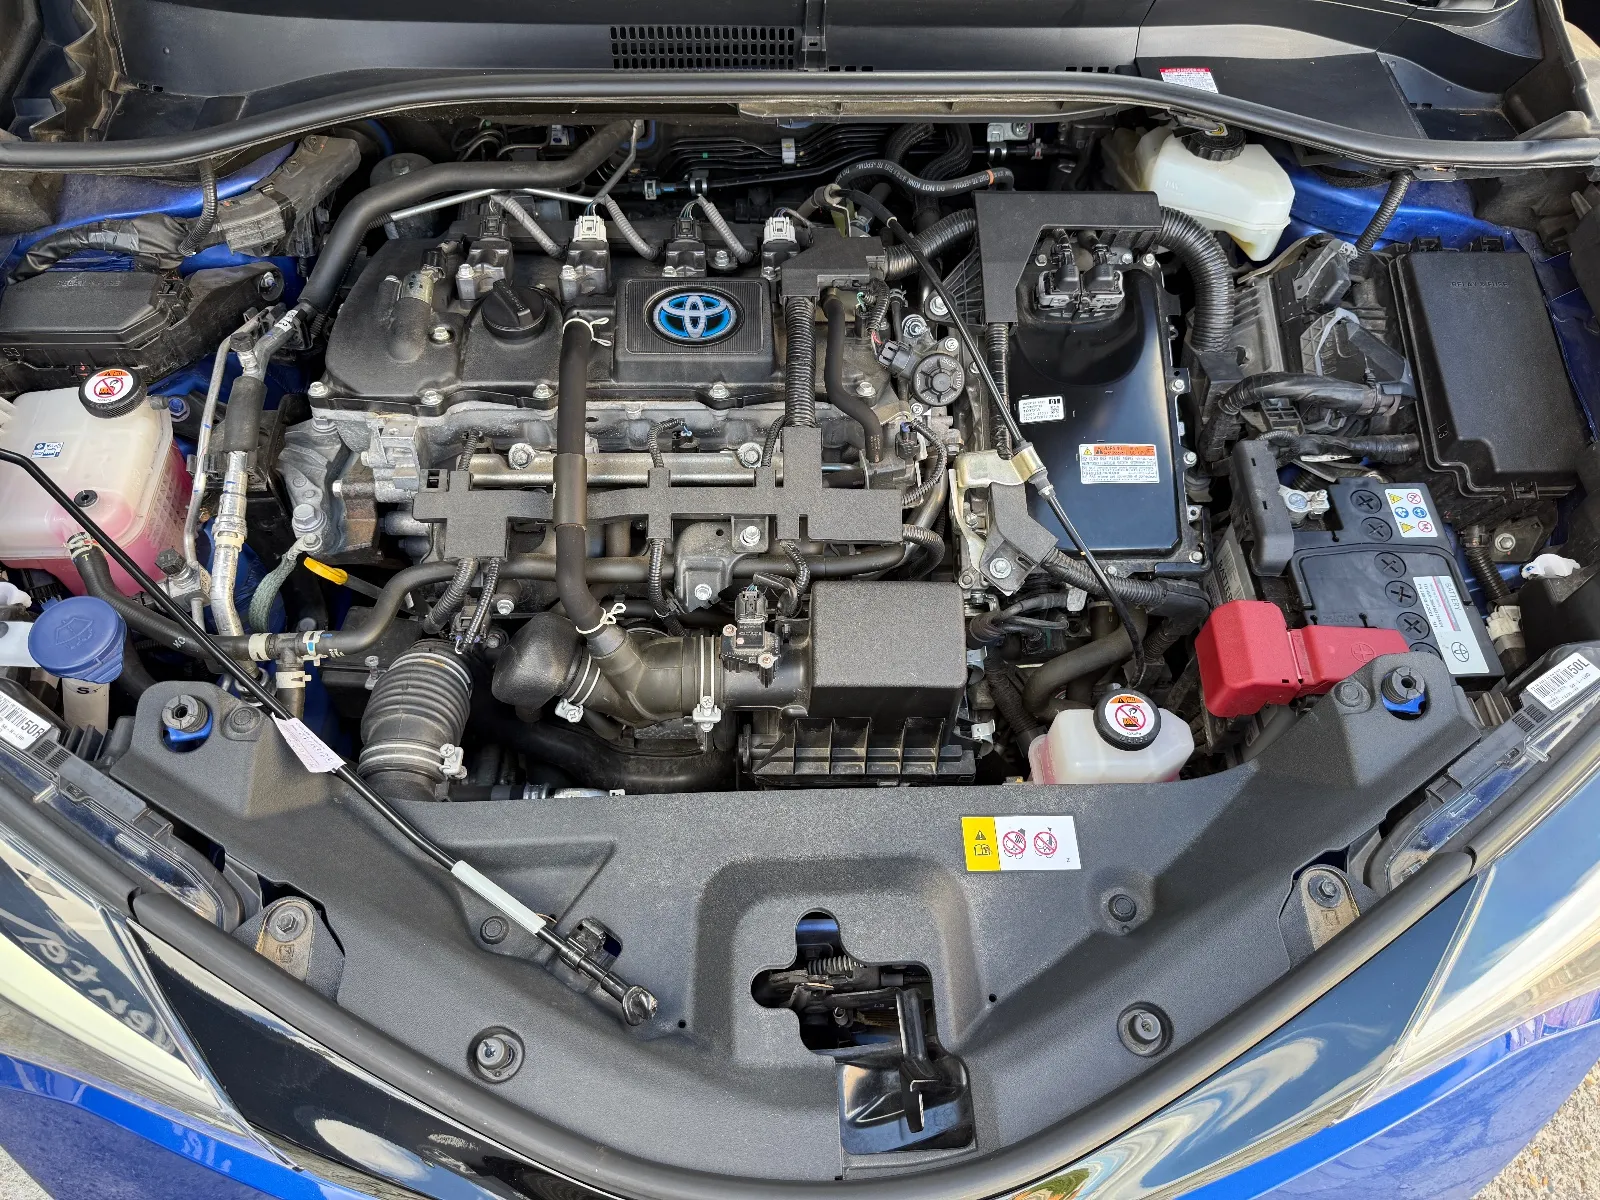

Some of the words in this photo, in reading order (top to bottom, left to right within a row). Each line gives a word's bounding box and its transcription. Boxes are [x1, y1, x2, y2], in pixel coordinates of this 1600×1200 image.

[1444, 582, 1463, 611] BATTERY
[1566, 658, 1591, 675] 50L
[20, 719, 47, 739] 50R
